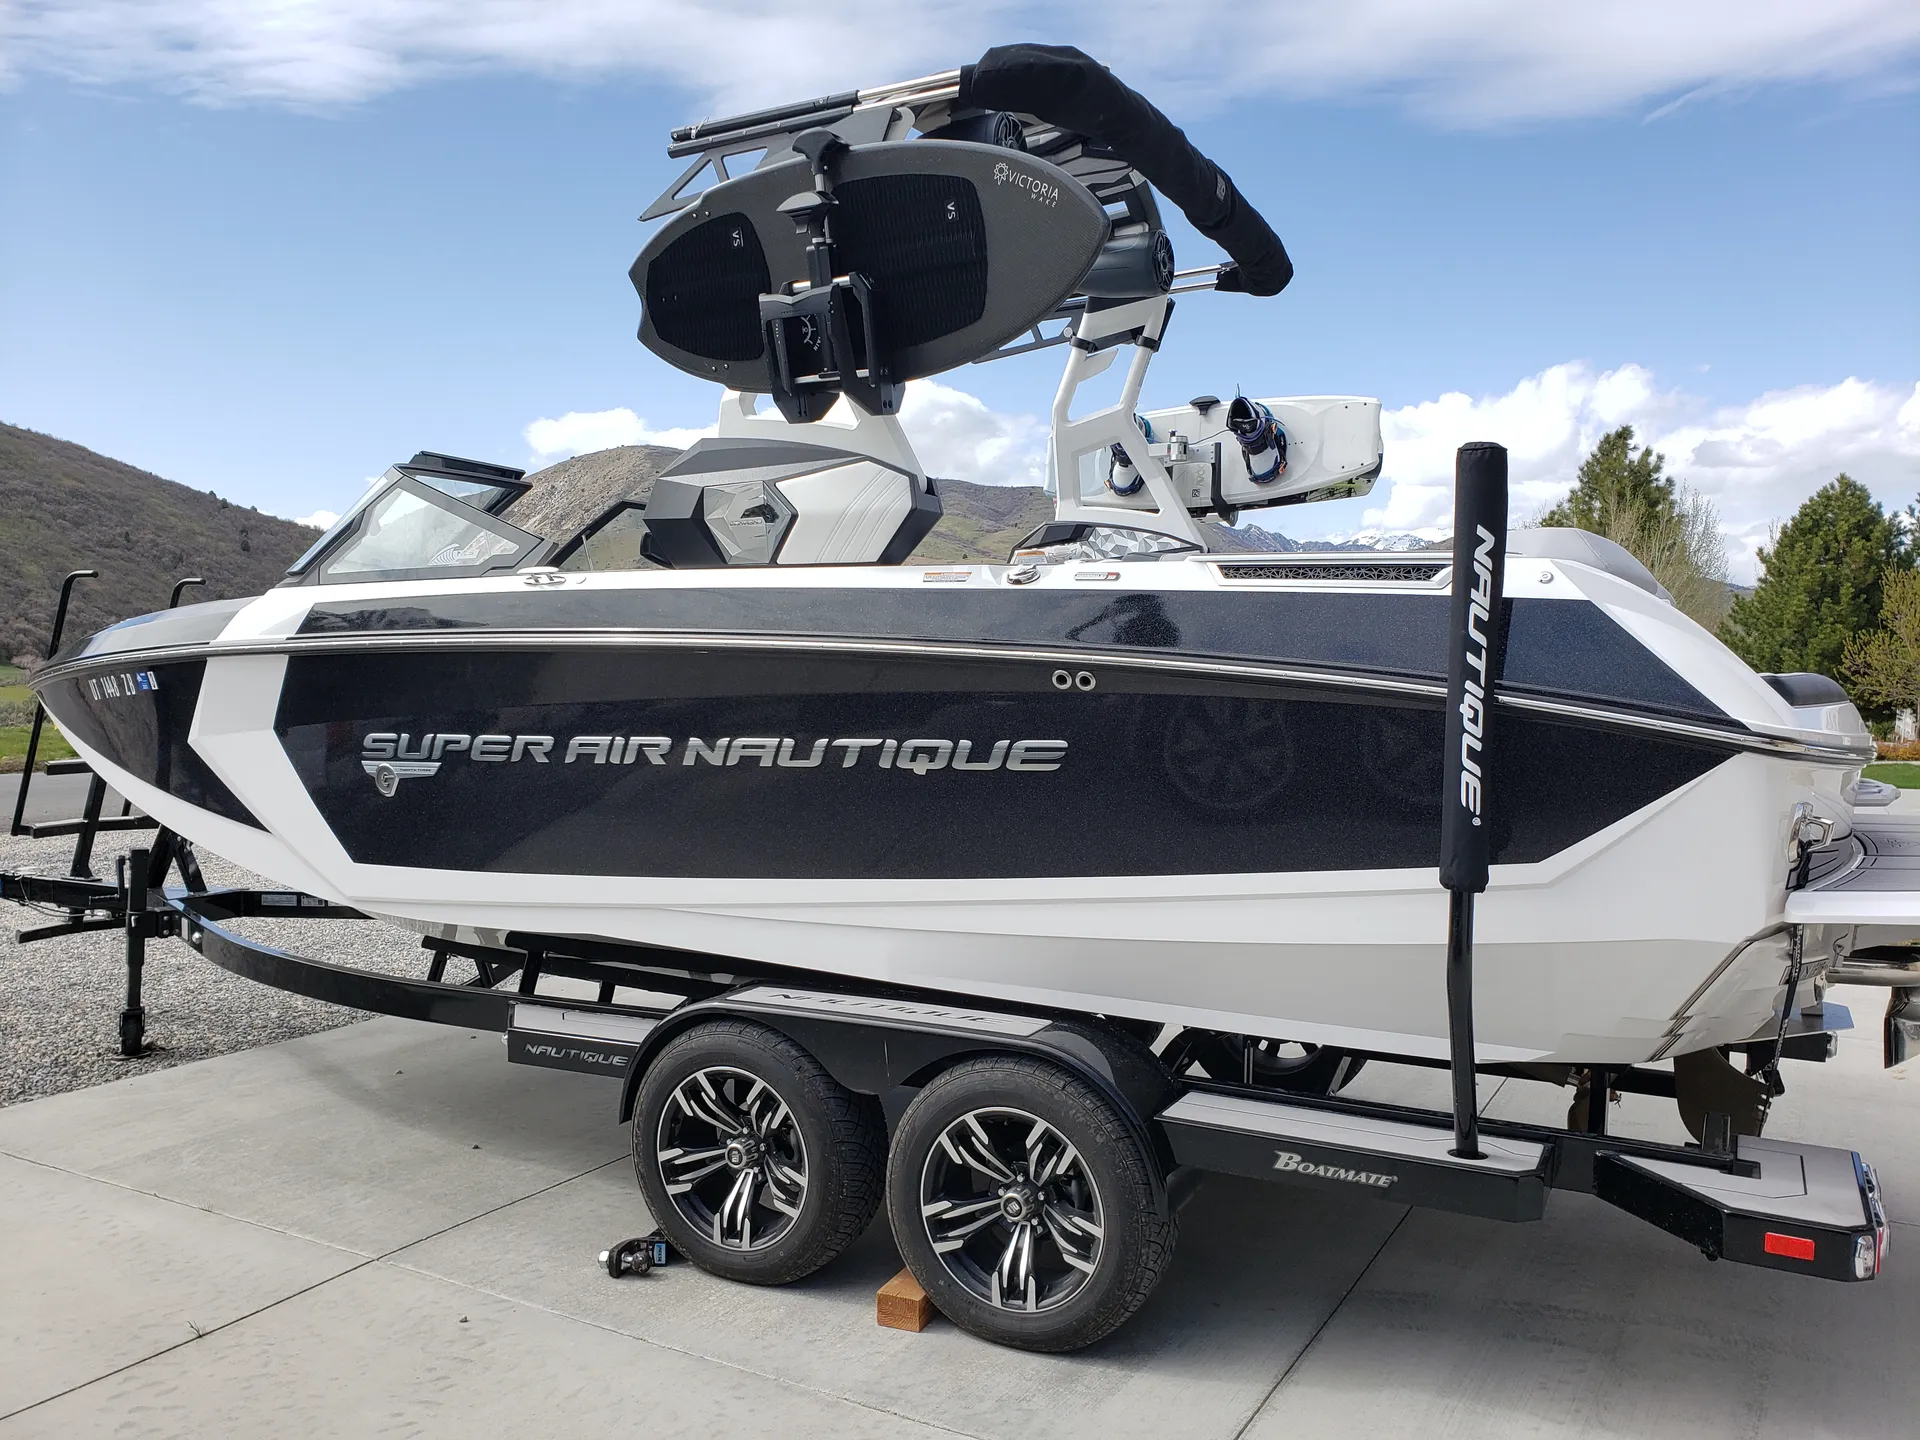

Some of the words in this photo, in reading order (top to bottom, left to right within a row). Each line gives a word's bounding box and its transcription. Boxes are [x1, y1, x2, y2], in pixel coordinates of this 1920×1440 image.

[1008, 170, 1059, 201] VICTORIA
[1030, 193, 1057, 208] WAKE
[88, 679, 101, 701] UT
[361, 732, 555, 763] SUPER
[564, 735, 672, 765] AIR
[682, 737, 1069, 775] NAUTIQUE
[523, 1043, 629, 1066] NAUTIQUE
